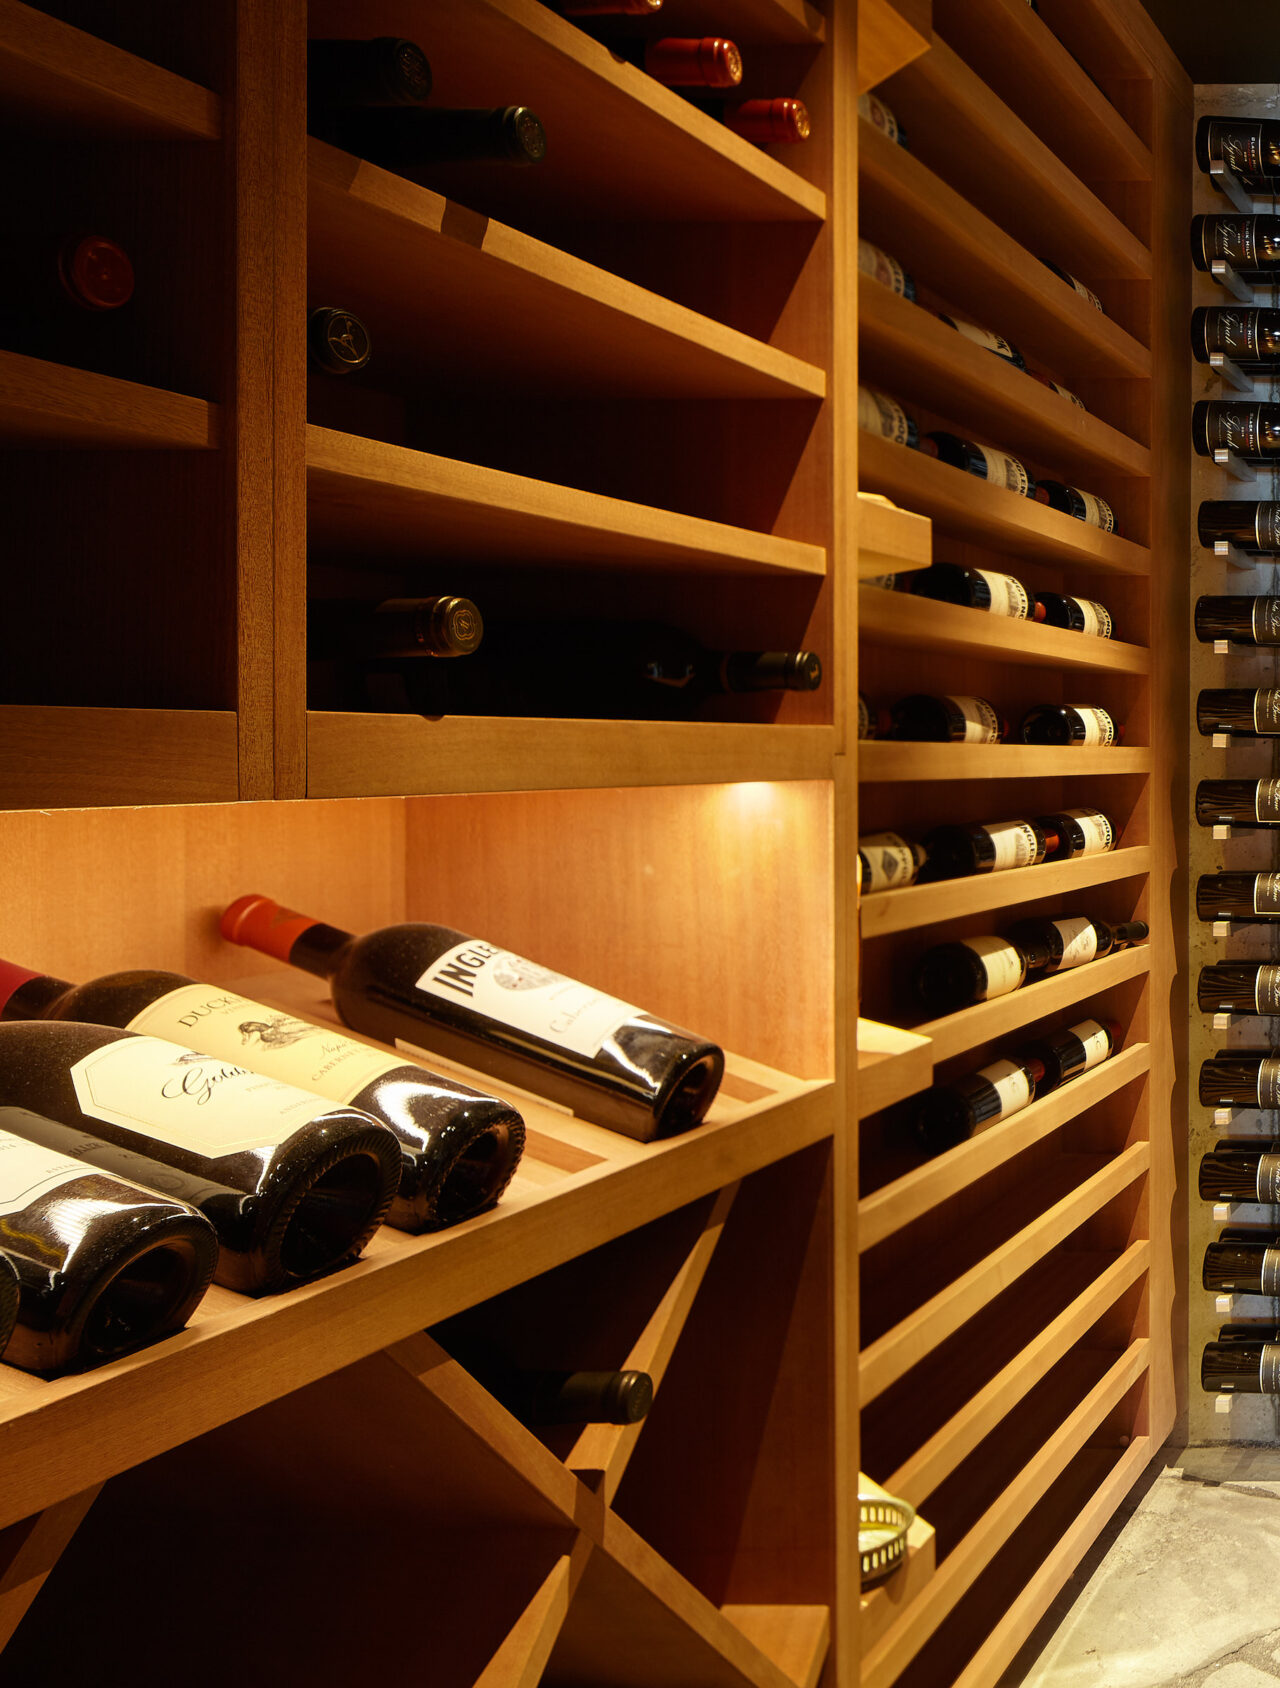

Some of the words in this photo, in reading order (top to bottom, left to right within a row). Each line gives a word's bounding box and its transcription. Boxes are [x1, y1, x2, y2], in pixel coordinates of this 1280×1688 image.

[1223, 134, 1243, 172] Syrah
[1217, 220, 1236, 258] Syrah
[1220, 310, 1239, 346] Syrah
[1220, 412, 1240, 450] Syrah
